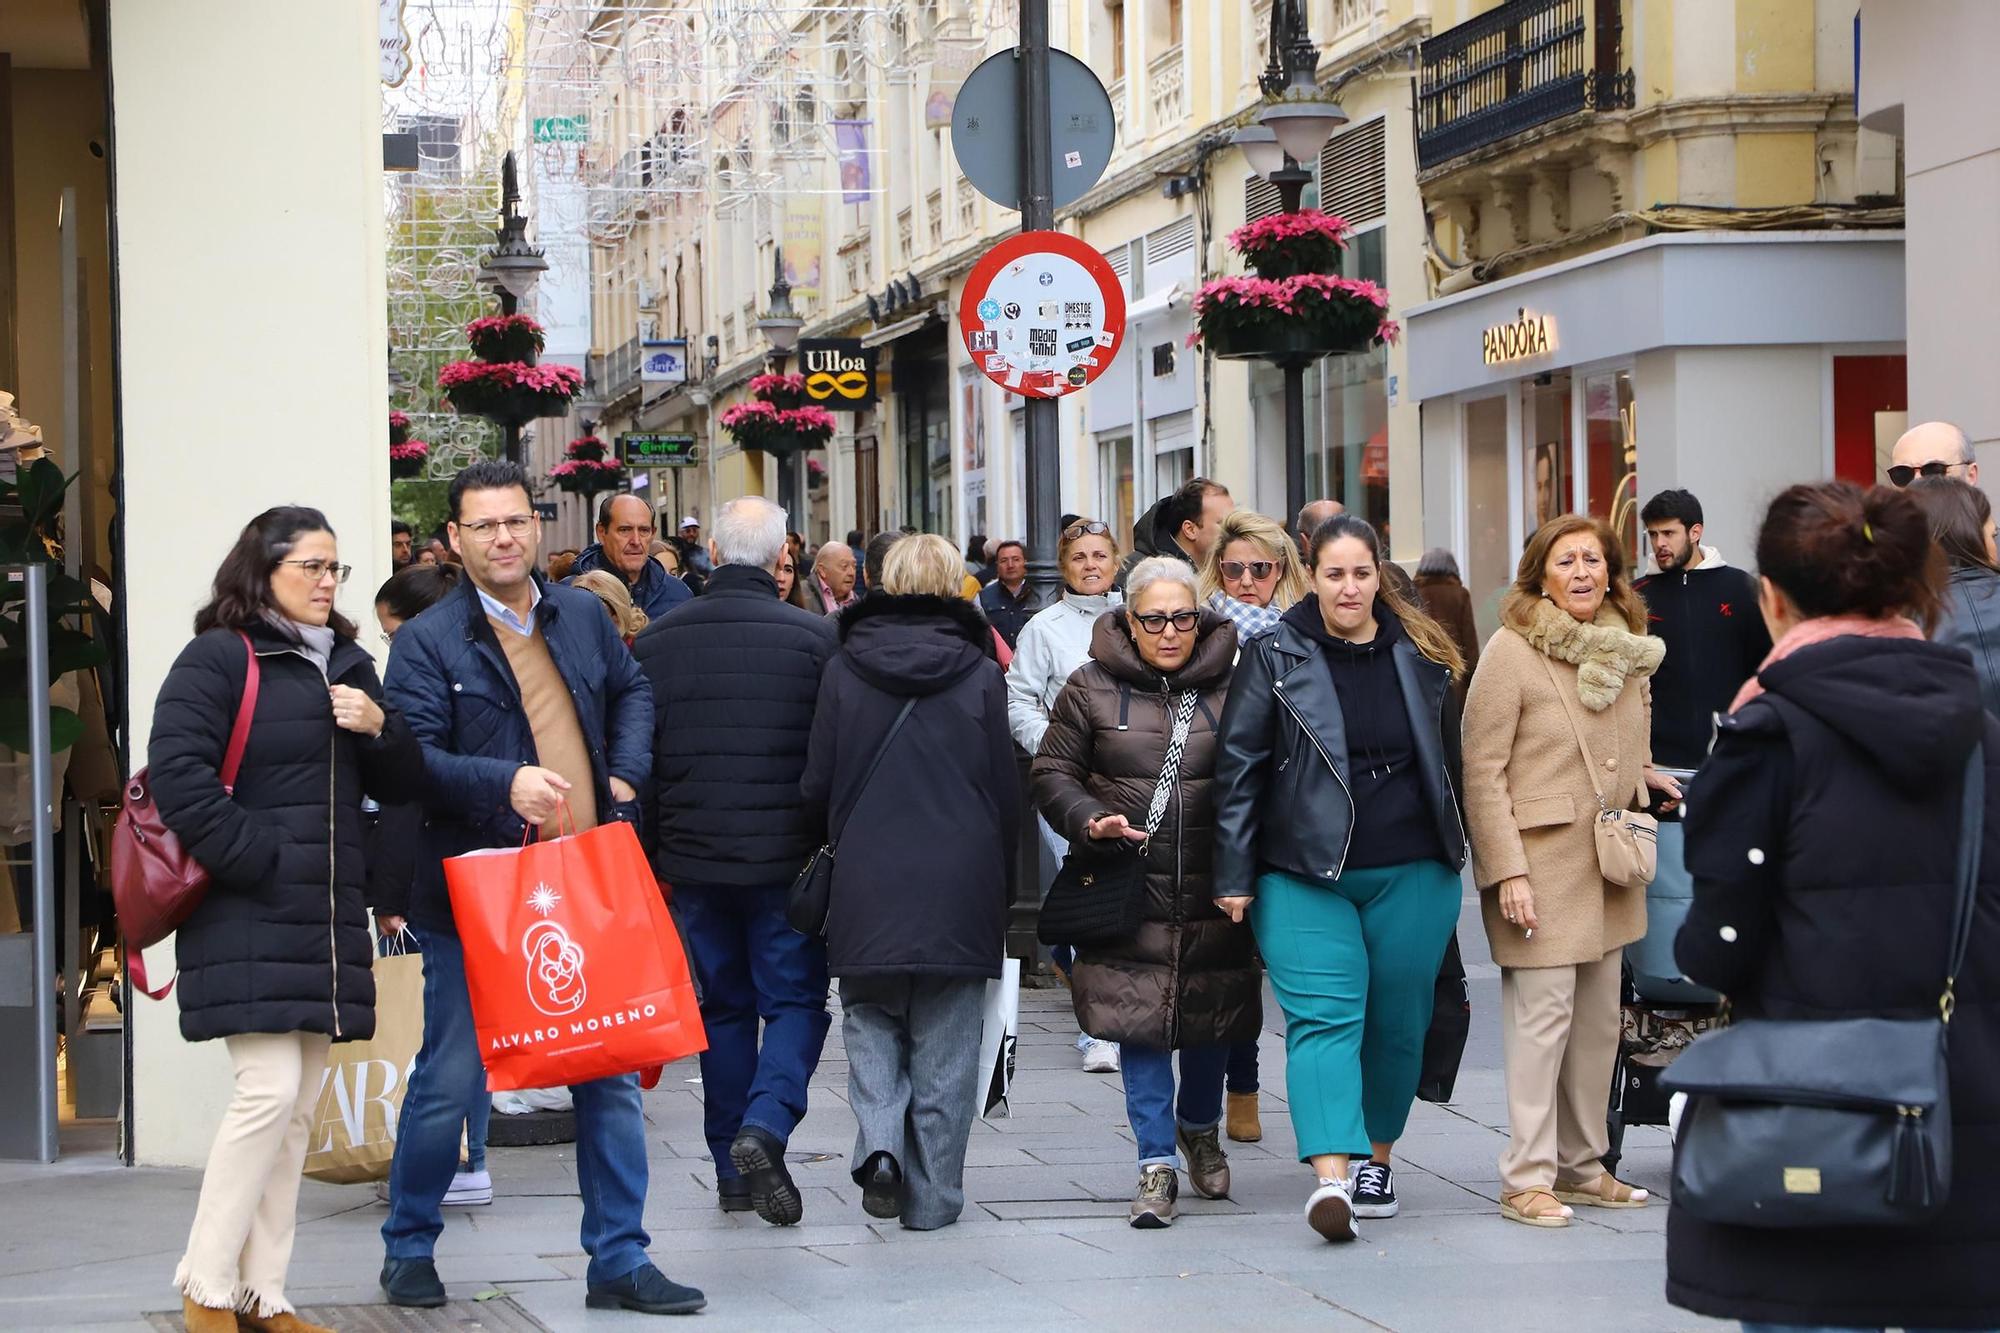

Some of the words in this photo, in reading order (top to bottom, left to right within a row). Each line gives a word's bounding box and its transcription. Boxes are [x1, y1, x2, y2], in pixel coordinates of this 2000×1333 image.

[805, 350, 866, 372] Ulloa
[1483, 315, 1548, 364] PANDORA
[492, 1027, 559, 1050] ALVARO
[570, 1004, 656, 1036] MORENO
